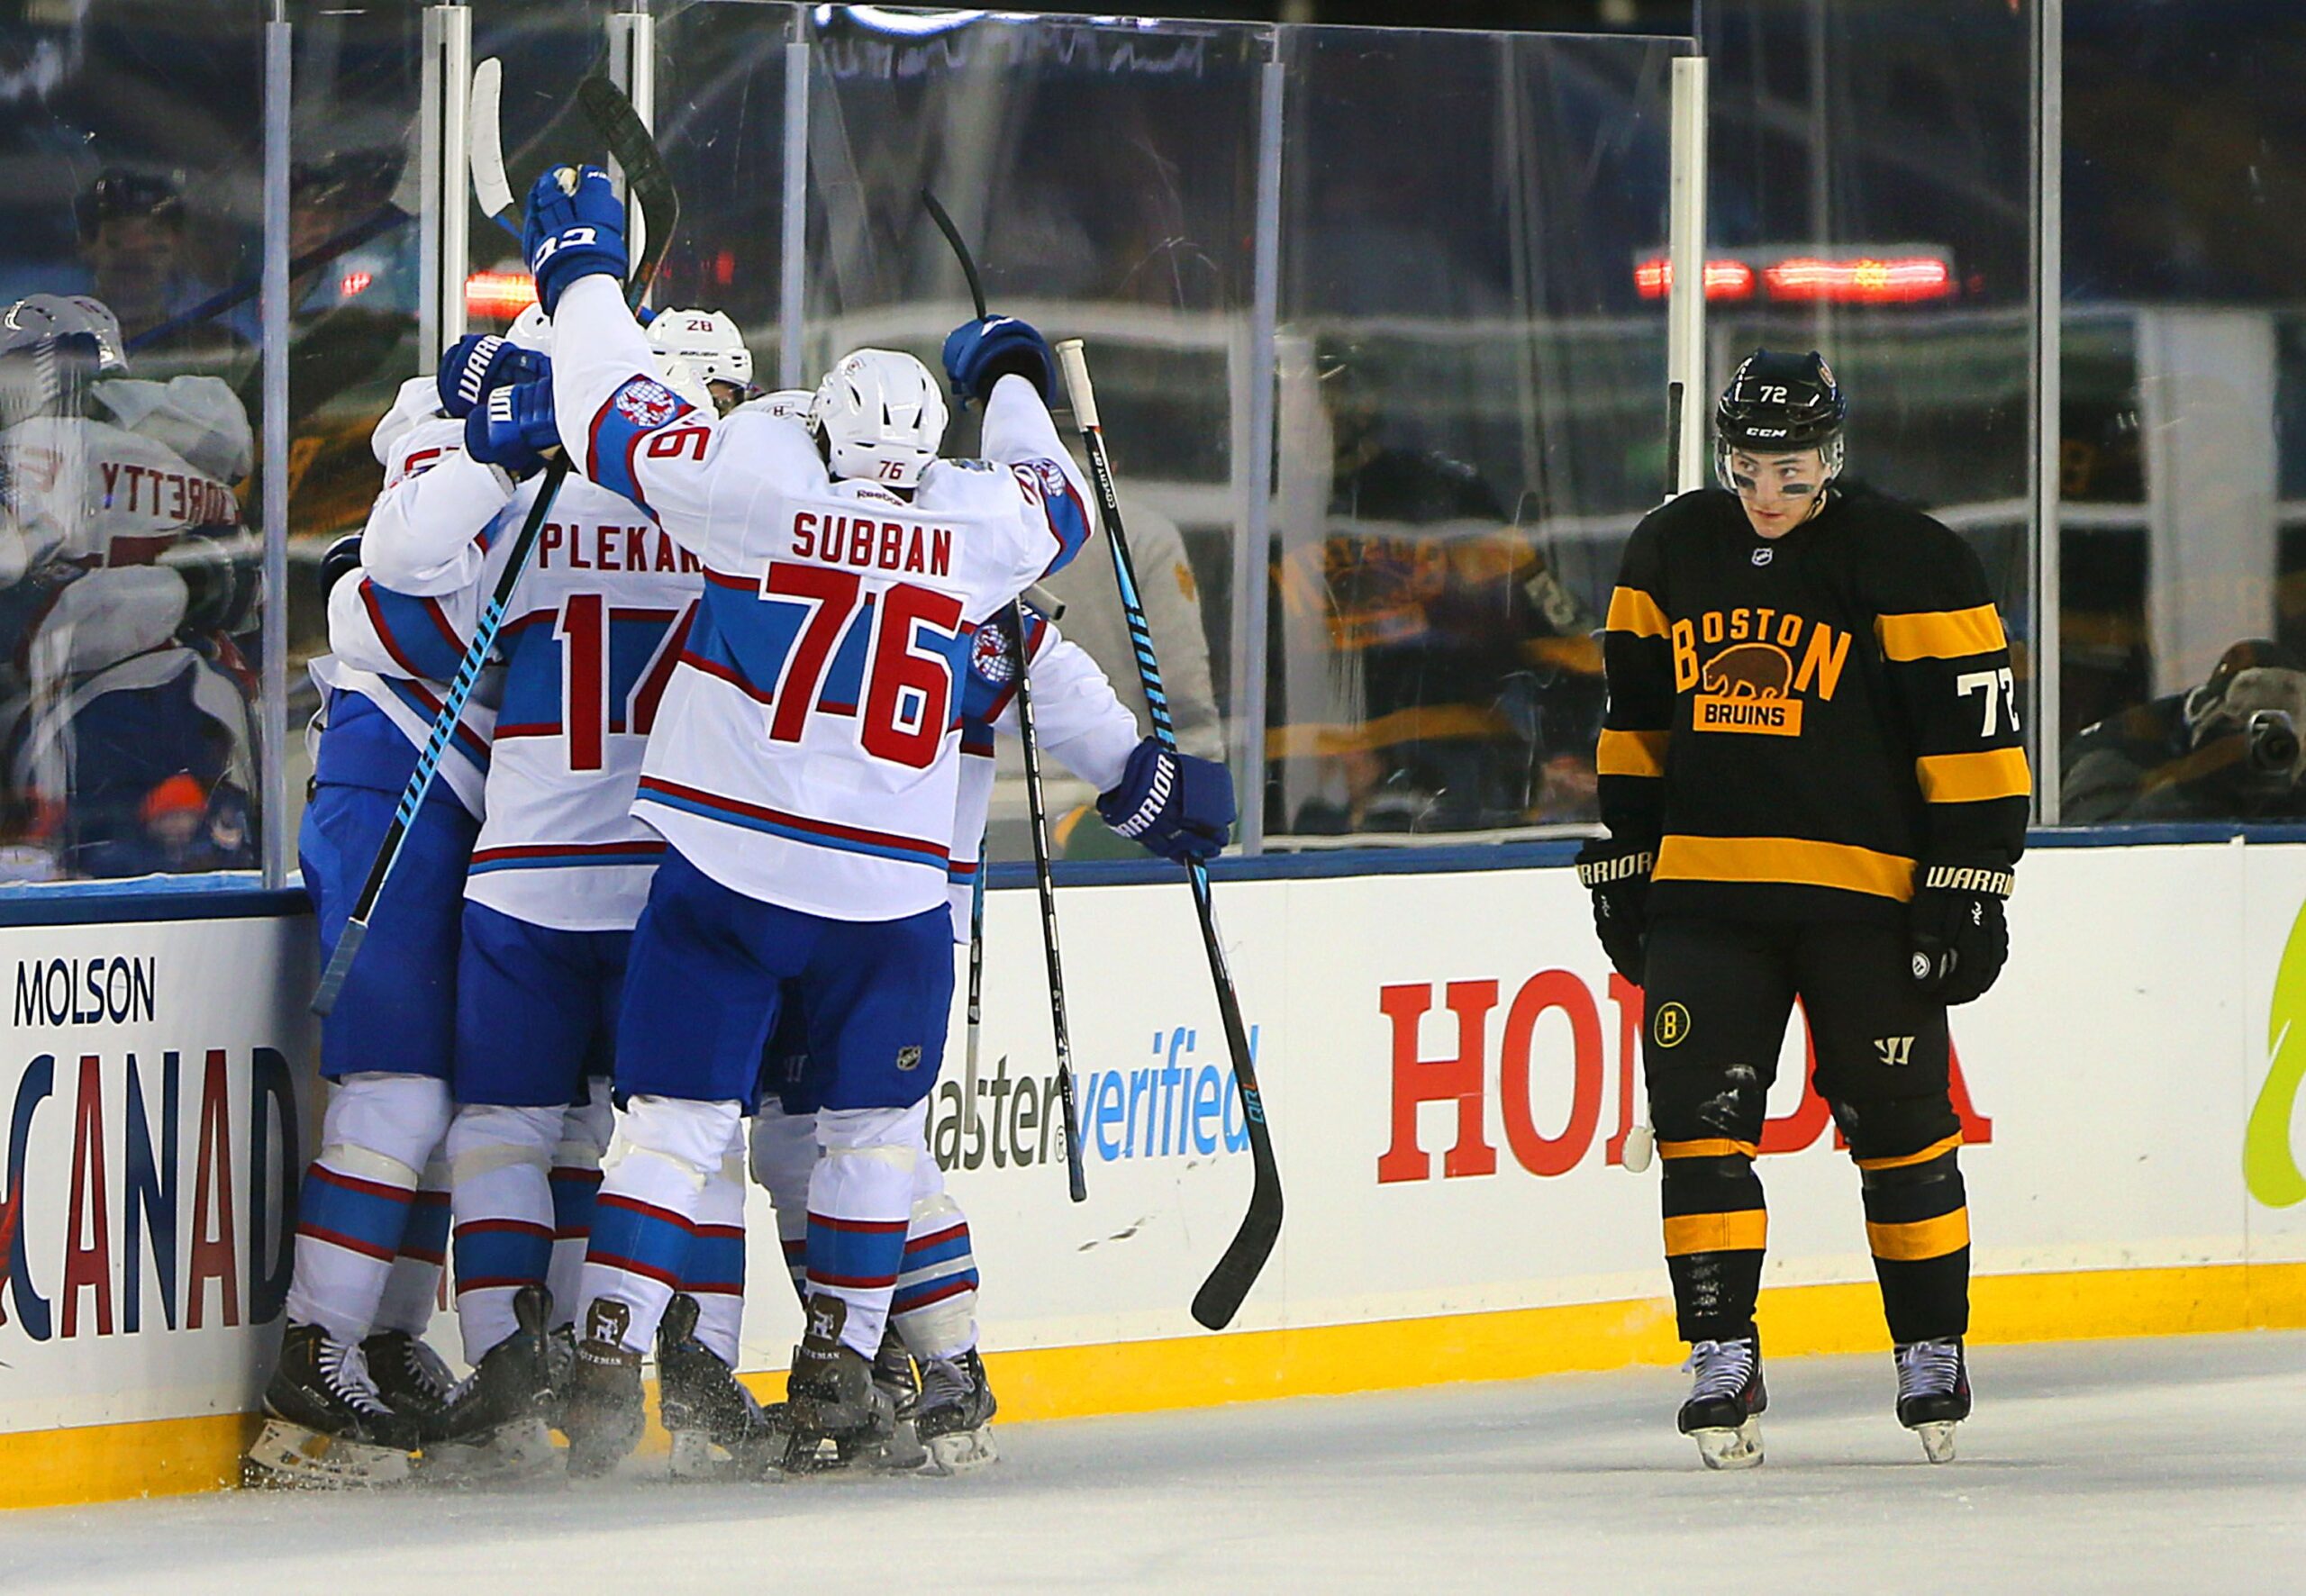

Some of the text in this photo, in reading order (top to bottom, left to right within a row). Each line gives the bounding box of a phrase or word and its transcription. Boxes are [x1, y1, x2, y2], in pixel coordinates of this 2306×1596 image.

[687, 319, 713, 332] 28
[1760, 385, 1788, 404] 72
[1746, 427, 1787, 438] CCM
[878, 460, 904, 480] 76
[792, 512, 951, 576] SUBBAN
[766, 561, 964, 769] 76
[1672, 608, 1852, 702] BOSTON
[1704, 703, 1785, 726] BRUINS
[1956, 667, 2020, 738] 72
[1576, 851, 1653, 884] RRIOR
[14, 956, 156, 1027] MOLSON
[1071, 1024, 1259, 1162] verified
